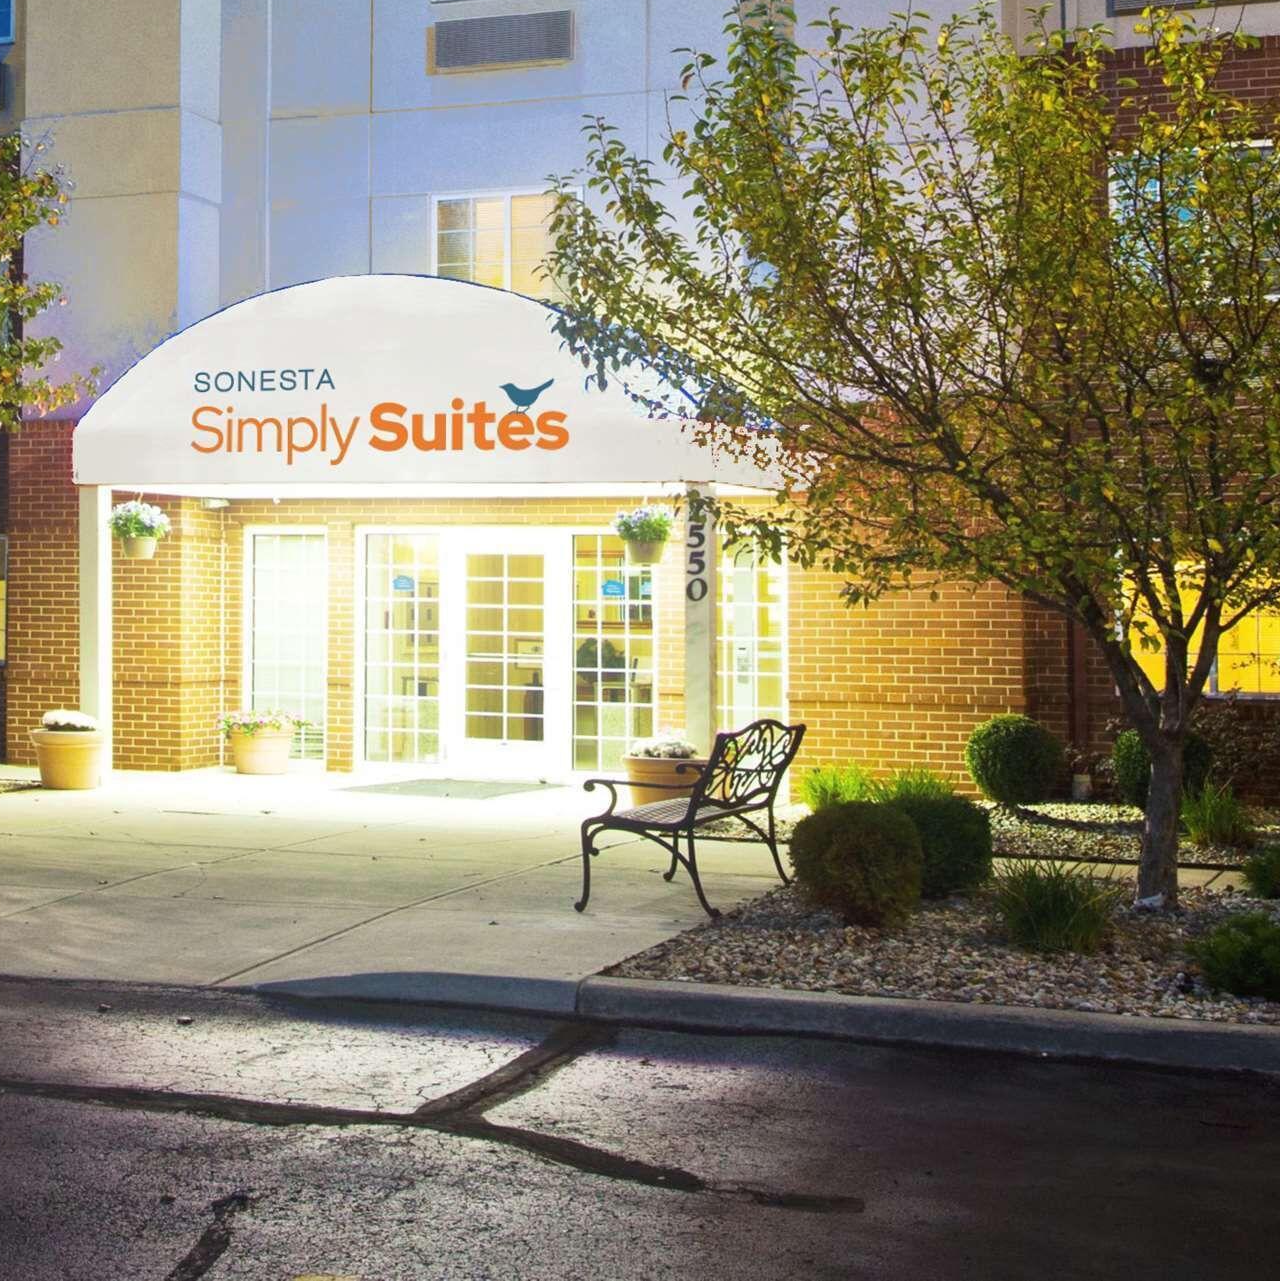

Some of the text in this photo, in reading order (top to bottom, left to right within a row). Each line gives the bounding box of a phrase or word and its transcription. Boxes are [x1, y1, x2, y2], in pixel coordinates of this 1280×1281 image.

[194, 369, 336, 393] SONESTA
[191, 397, 570, 466] Simply Suites
